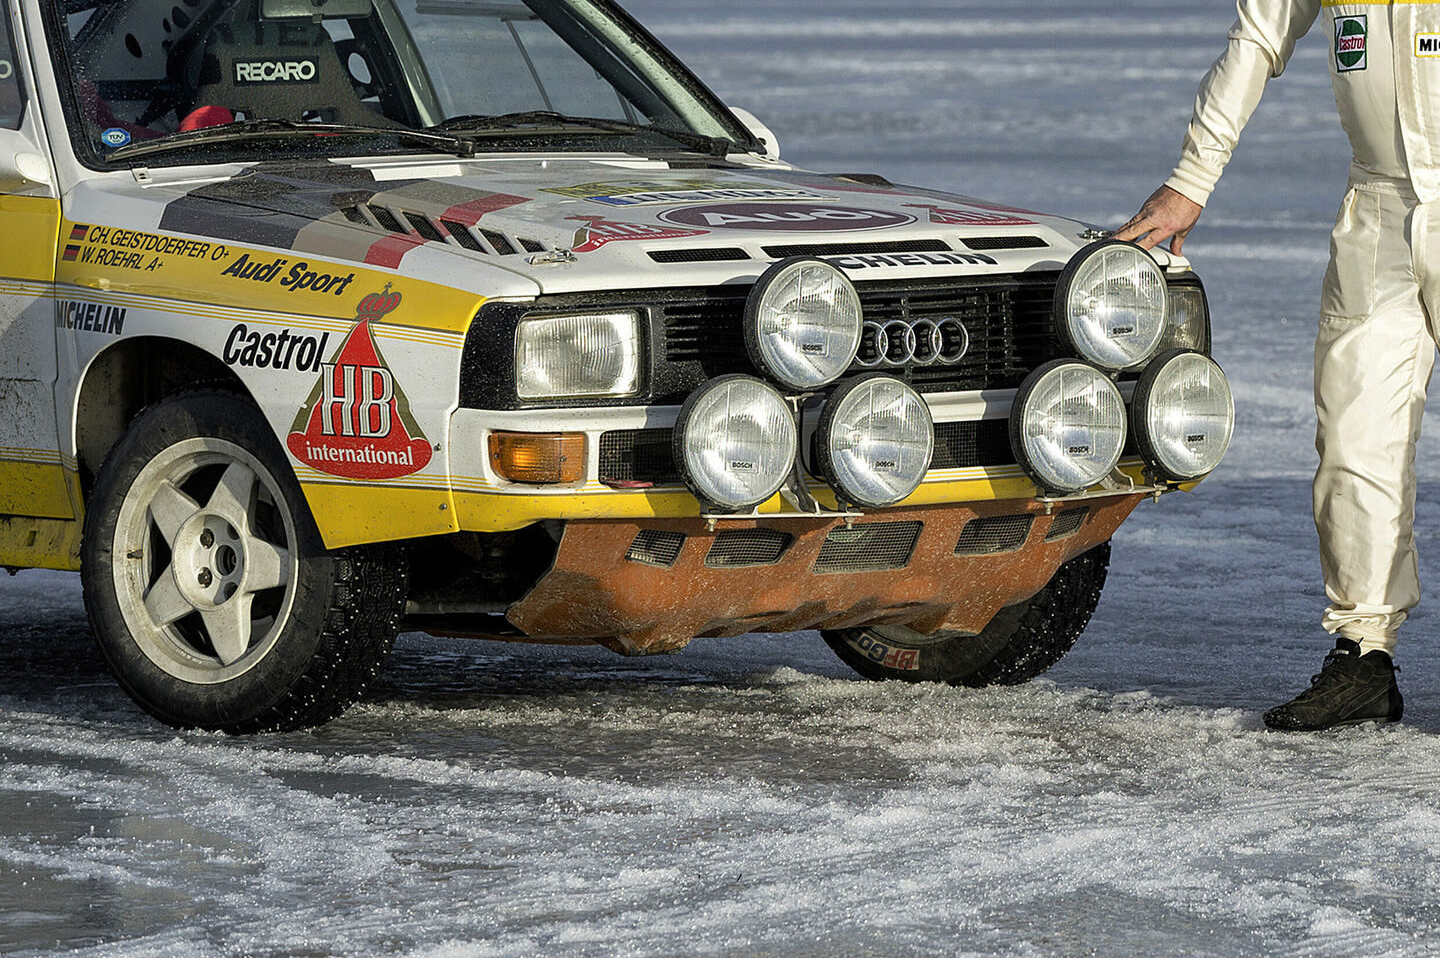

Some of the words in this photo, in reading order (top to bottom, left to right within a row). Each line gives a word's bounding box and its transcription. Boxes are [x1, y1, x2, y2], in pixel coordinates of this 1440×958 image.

[1339, 37, 1366, 51] Castrol
[236, 61, 316, 81] RECARO
[834, 251, 998, 270] CHELIN
[220, 254, 288, 282] Audi
[280, 261, 355, 295] Sport
[223, 323, 329, 373] Castrol
[320, 363, 394, 439] HB
[306, 441, 414, 466] international
[732, 461, 753, 469] BOSCH
[875, 460, 895, 468] BOSCH
